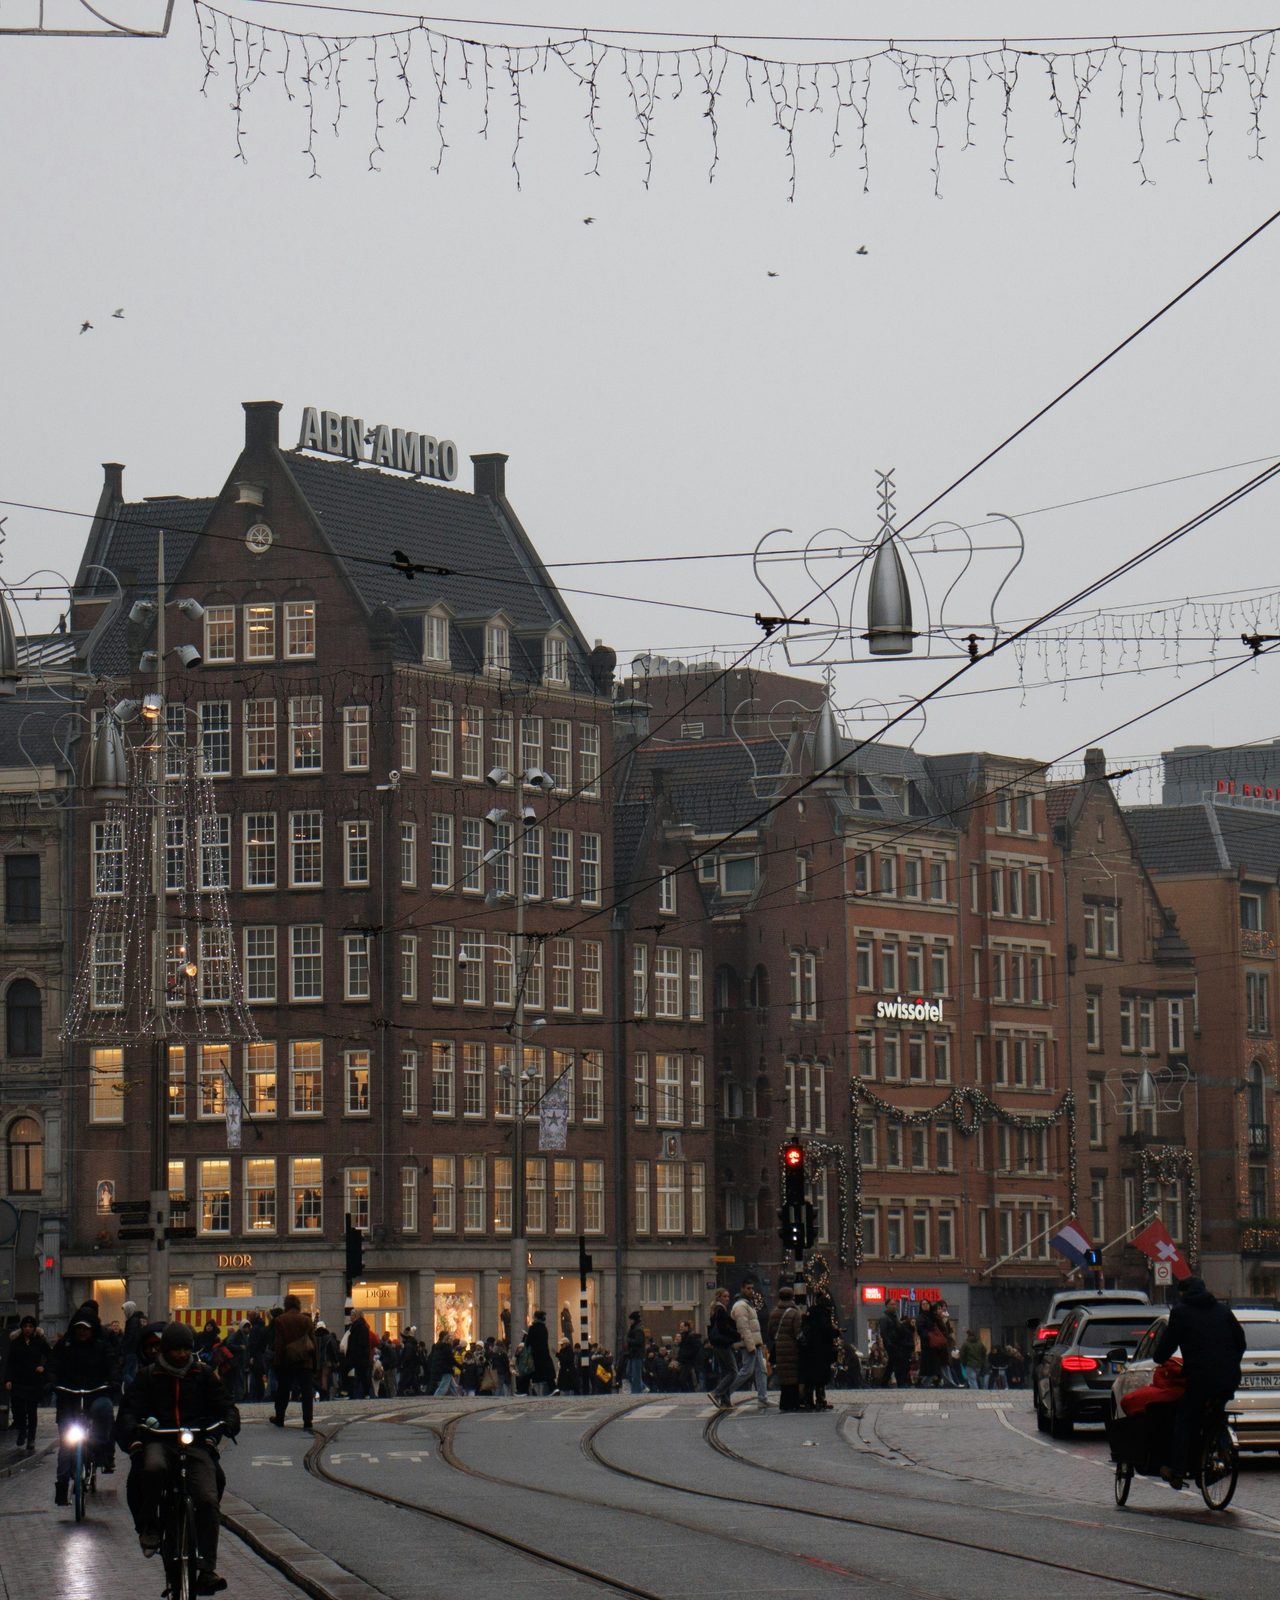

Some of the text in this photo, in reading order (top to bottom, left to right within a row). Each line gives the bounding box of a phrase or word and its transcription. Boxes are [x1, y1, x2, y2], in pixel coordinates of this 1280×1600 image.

[300, 406, 458, 481] ABN AMRO
[218, 1254, 252, 1267] DIOR
[366, 1290, 390, 1298] DIOR
